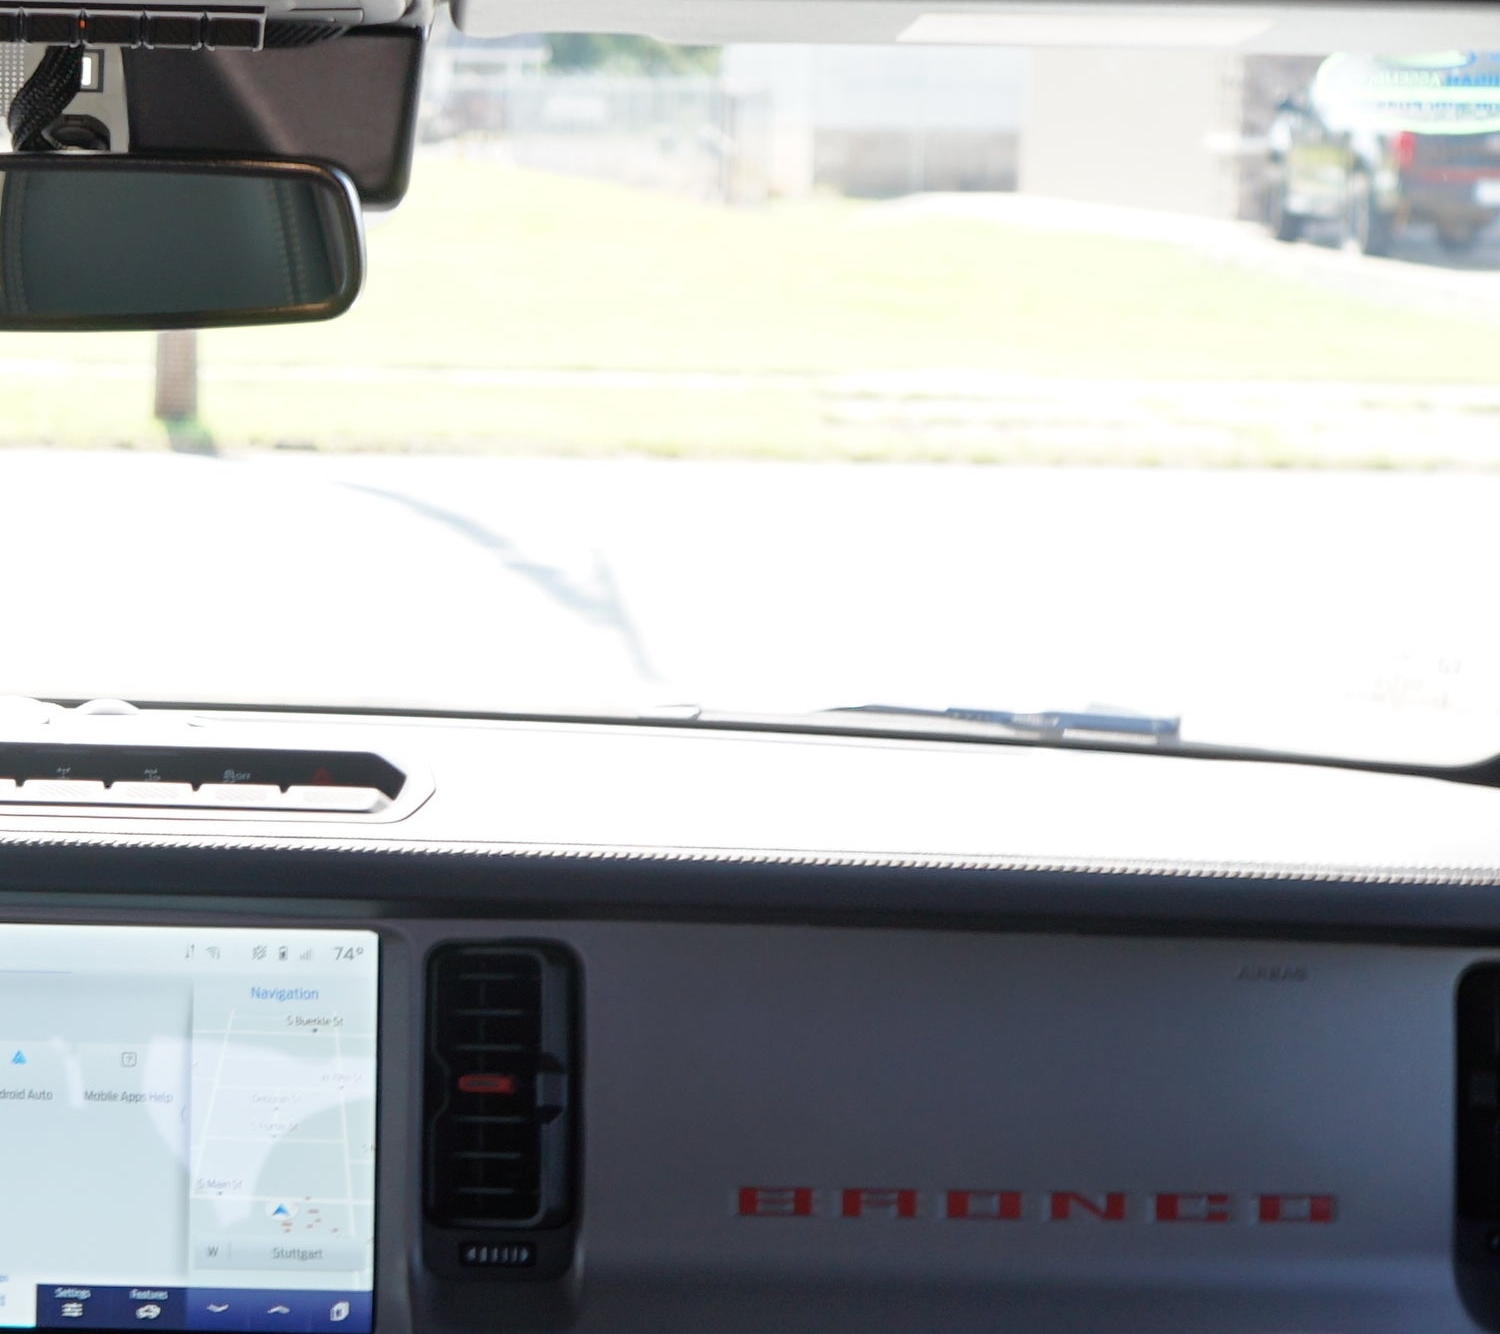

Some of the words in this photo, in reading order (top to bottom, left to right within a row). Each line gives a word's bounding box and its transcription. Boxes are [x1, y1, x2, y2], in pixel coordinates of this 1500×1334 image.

[250, 986, 320, 1002] Navigation
[332, 1017, 344, 1027] St
[27, 1087, 53, 1101] Auto
[84, 1089, 118, 1102] Mobile
[120, 1091, 146, 1103] Apps
[149, 1091, 173, 1104] Help
[737, 1187, 1338, 1223] BRONCO
[206, 1245, 219, 1257] W
[272, 1247, 323, 1261] Stuttgart
[54, 1287, 91, 1300] Settings
[129, 1288, 169, 1300] Features
